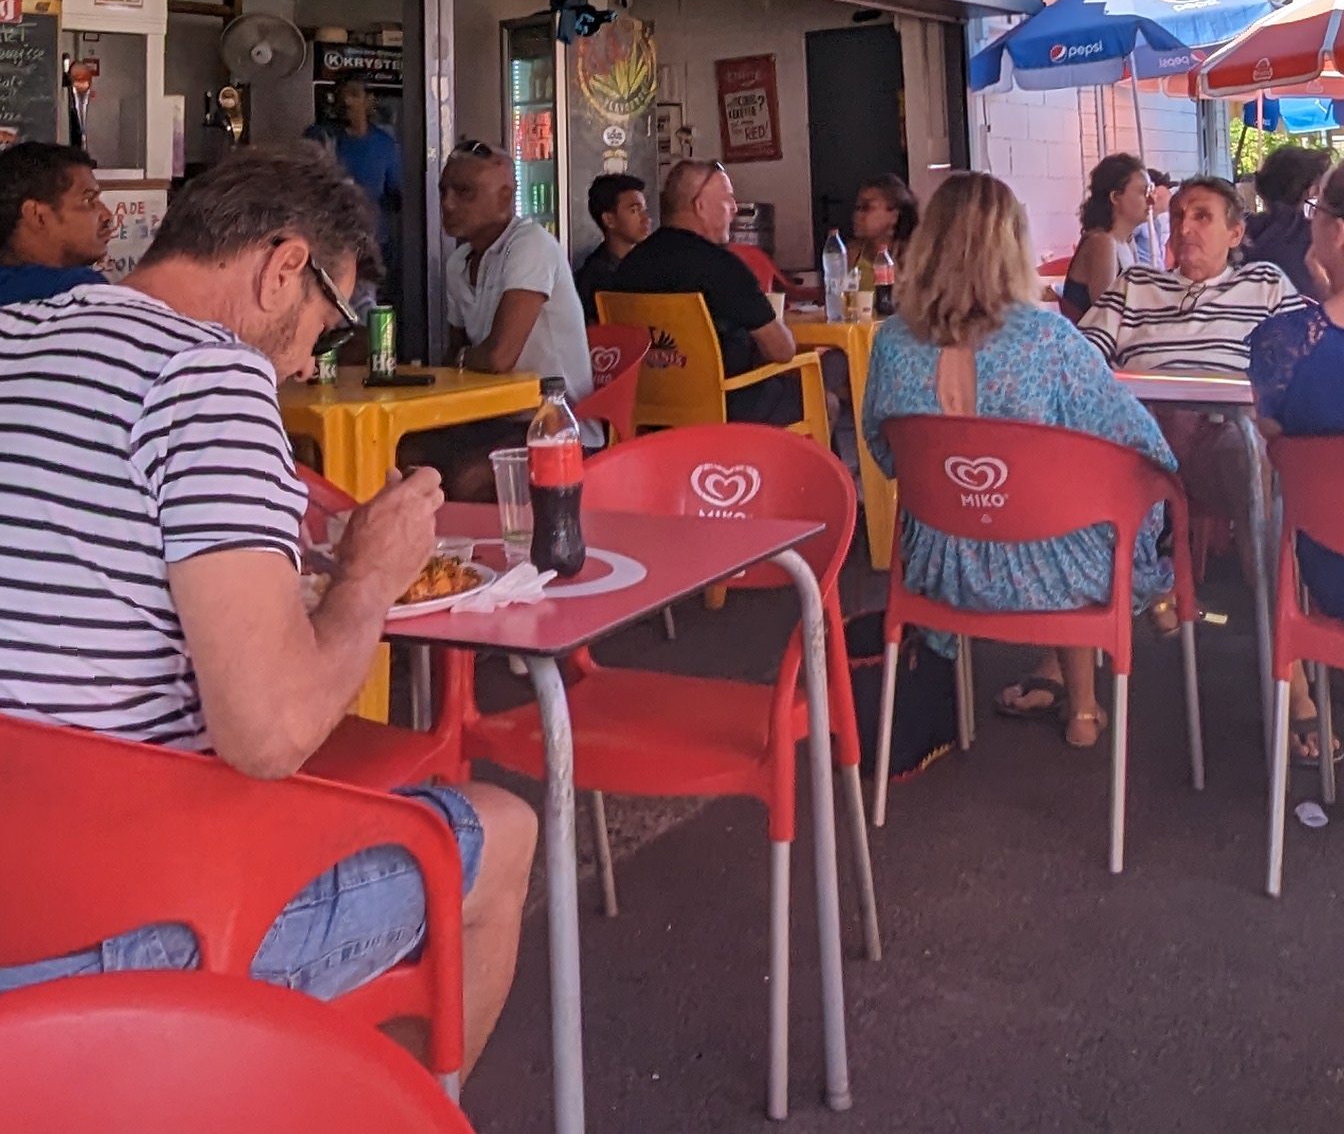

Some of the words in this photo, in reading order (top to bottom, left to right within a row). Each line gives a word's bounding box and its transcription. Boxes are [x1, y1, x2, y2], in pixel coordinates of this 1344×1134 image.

[1067, 39, 1103, 59] pepsi
[344, 56, 403, 71] KRYSTE
[114, 201, 145, 215] ADE
[960, 493, 1005, 508] MIKO
